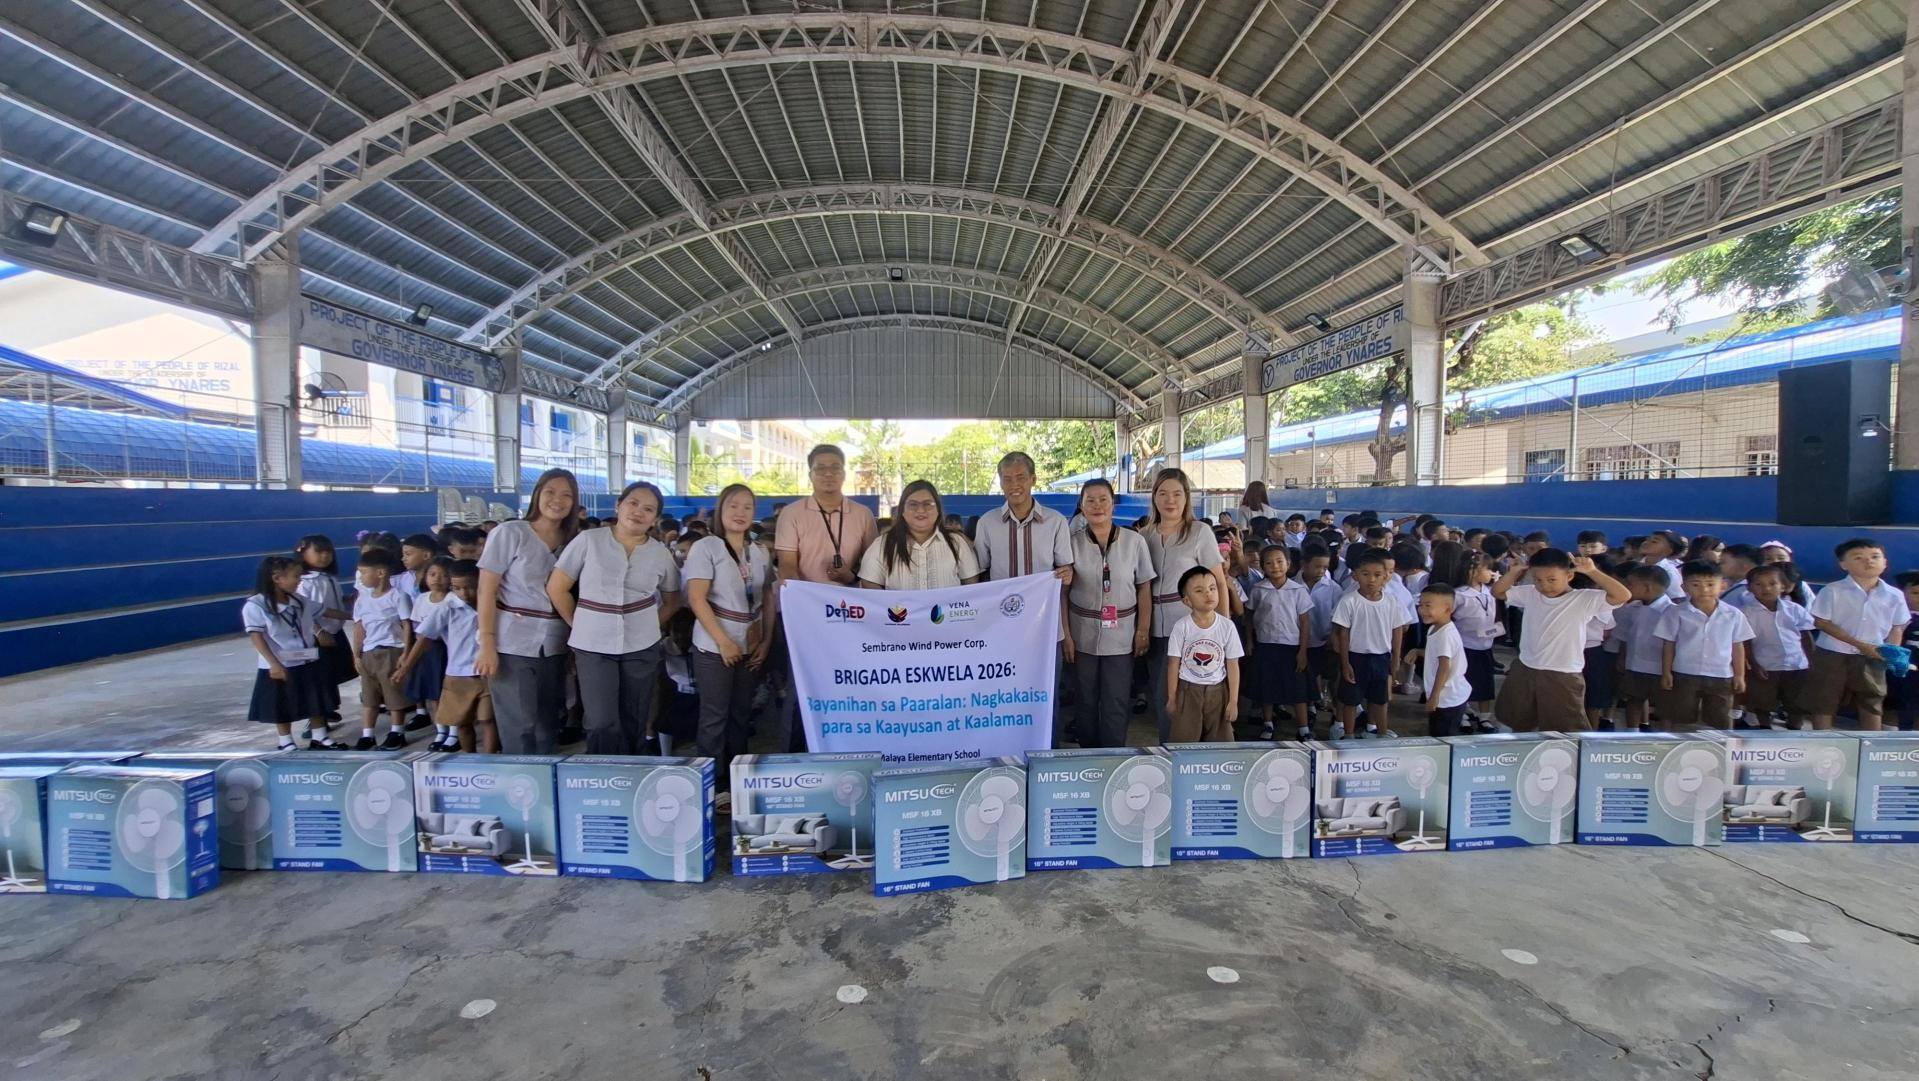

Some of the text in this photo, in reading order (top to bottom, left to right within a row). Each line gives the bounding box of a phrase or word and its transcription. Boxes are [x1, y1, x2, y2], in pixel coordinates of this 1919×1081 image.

[310, 301, 369, 331] PROJECT
[375, 323, 390, 337] OF
[394, 329, 415, 346] THE
[420, 336, 456, 358] PEOPLE
[1370, 330, 1380, 341] OF
[1276, 347, 1305, 367] PROJECT
[1308, 342, 1318, 355] OF
[1320, 335, 1336, 350] THE
[1338, 320, 1373, 344] PEOPLE
[1376, 313, 1390, 329] OF
[352, 339, 426, 372] GOVERNOR
[431, 360, 474, 383] YNARES
[1294, 336, 1392, 380] GOVERNOR YNARES
[133, 361, 151, 369] THE
[156, 361, 192, 370] PEOPLE
[198, 362, 209, 370] OF
[214, 362, 240, 371] RIZAL
[168, 379, 230, 391] YNARES
[949, 600, 970, 609] VENA
[826, 604, 865, 623] DepED
[949, 608, 979, 618] ENERGY
[862, 639, 987, 653] Sembrano Wind Power Corp.
[834, 661, 1016, 685] BRIGADA ESKWELA 2026:
[881, 700, 896, 712] sa
[900, 694, 966, 712] Paaralan:
[971, 687, 1048, 708] Nagkakaisa
[822, 712, 1033, 738] para sa Kaayusan at Kaalaman
[908, 750, 953, 762] Elementary
[954, 749, 980, 759] School
[1590, 753, 1631, 763] MITSU
[1731, 750, 1776, 761] MITSU
[1869, 751, 1907, 761] MITSU
[1327, 761, 1371, 774] MITSU
[1460, 756, 1496, 768] MITSU
[1179, 764, 1219, 774] MITSU
[278, 774, 319, 784] MITSU
[424, 775, 469, 788] MITSU
[566, 778, 608, 789] MITSU
[744, 777, 792, 789] MITSU
[1037, 772, 1078, 783] MITSU
[53, 790, 93, 801] MITSU
[885, 789, 929, 802] MITSU
[894, 883, 916, 891] STAND
[917, 881, 930, 889] FAN
